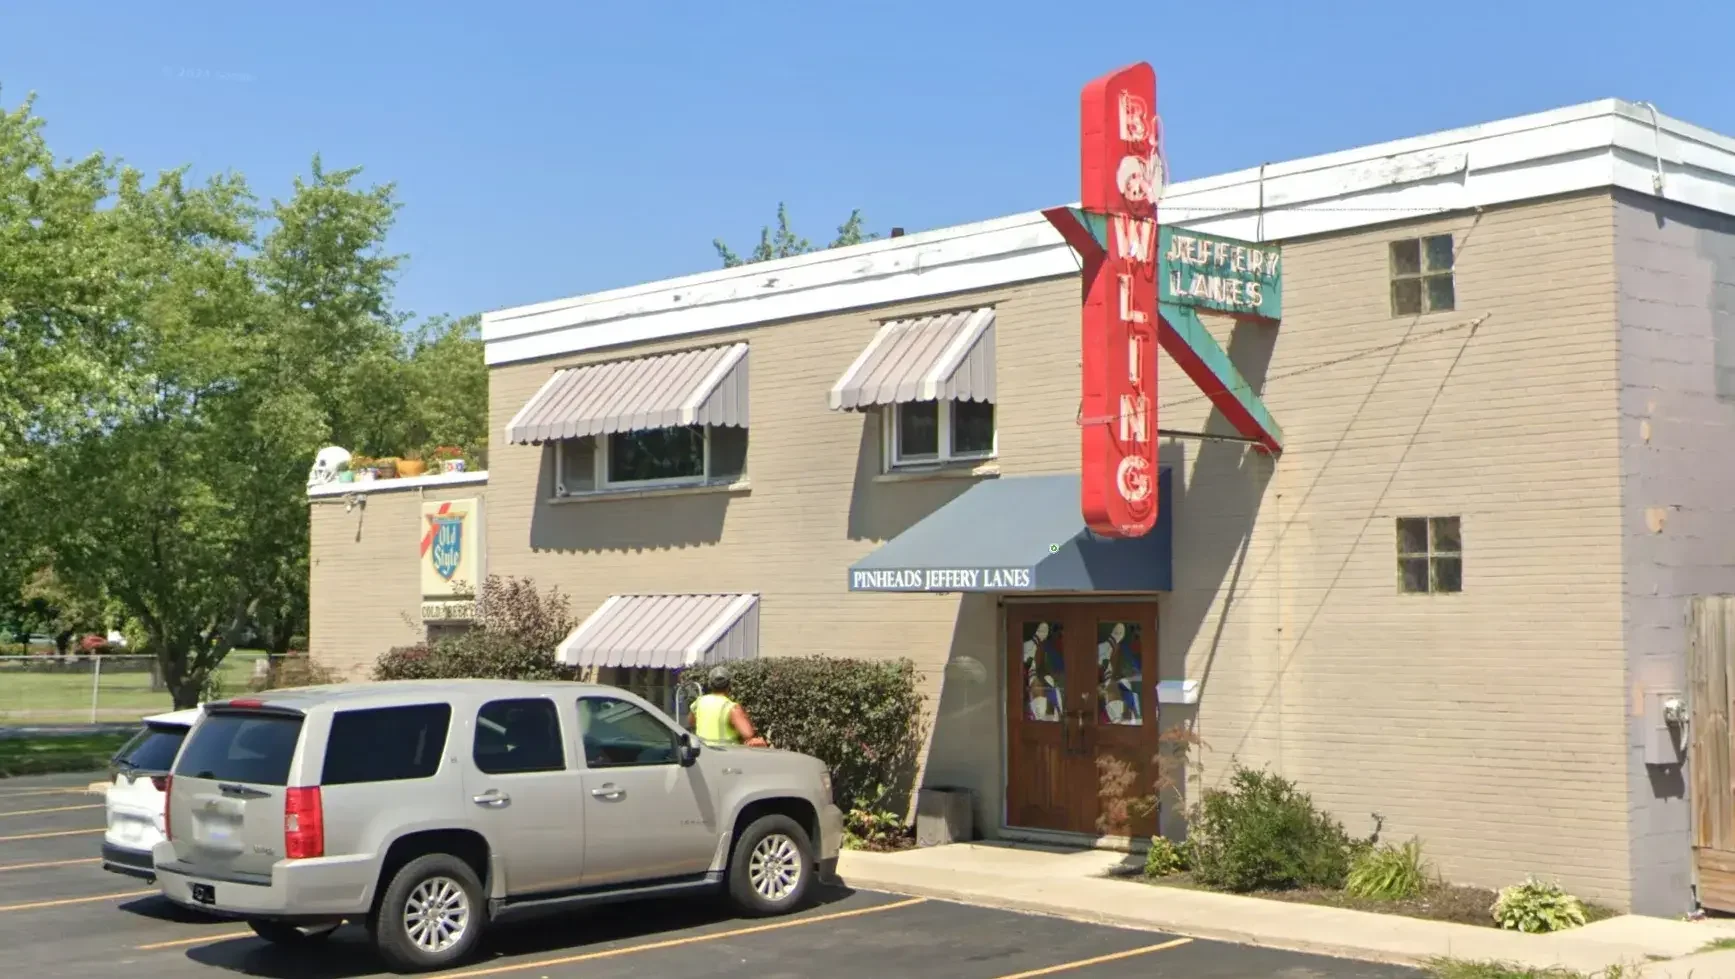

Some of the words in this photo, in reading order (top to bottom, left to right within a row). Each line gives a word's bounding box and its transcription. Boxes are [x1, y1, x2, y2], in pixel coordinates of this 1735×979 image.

[1165, 235, 1279, 277] JEFFERY
[1115, 91, 1157, 502] BOWLING
[1169, 271, 1263, 307] LANES
[439, 523, 457, 546] Old
[434, 544, 459, 576] Style
[853, 569, 922, 588] PINHEADS
[924, 569, 980, 590] JEFFERY
[983, 568, 1030, 588] LANES
